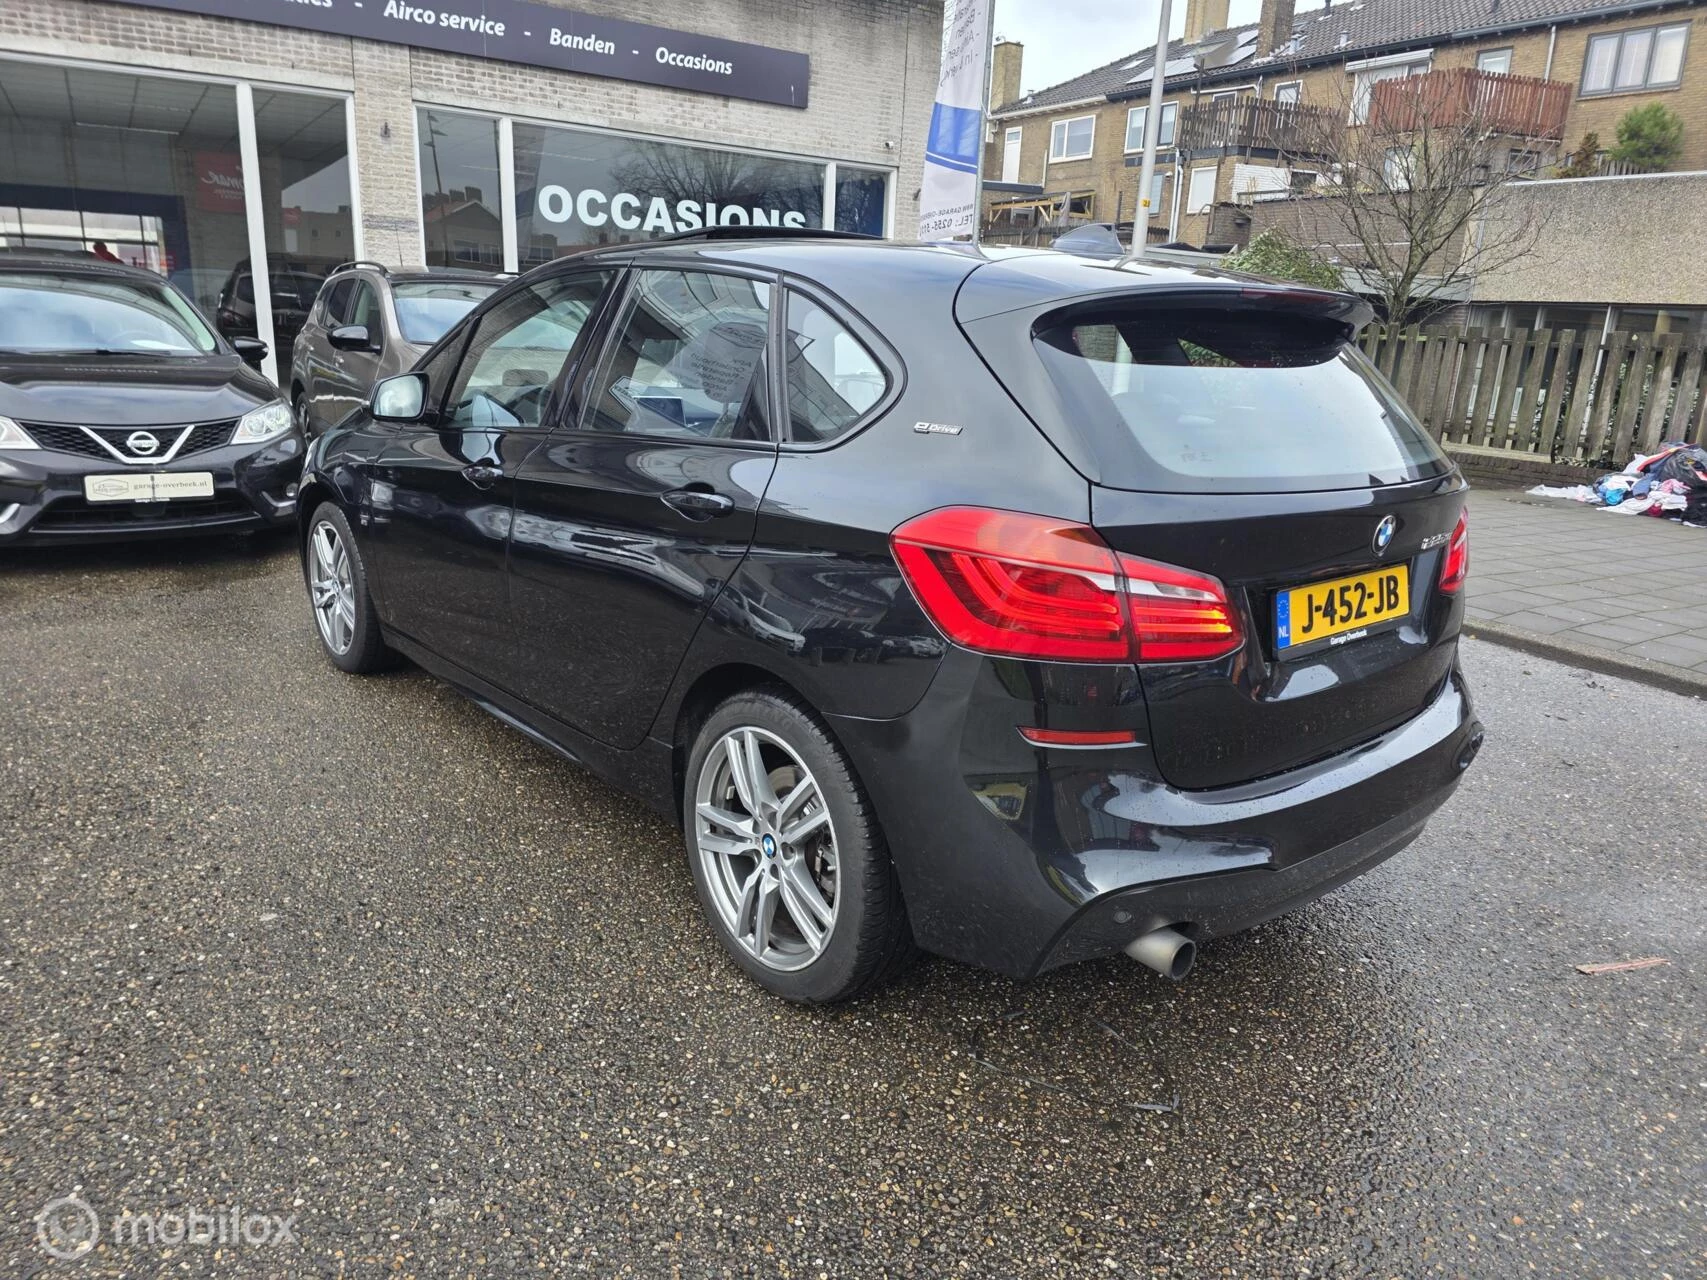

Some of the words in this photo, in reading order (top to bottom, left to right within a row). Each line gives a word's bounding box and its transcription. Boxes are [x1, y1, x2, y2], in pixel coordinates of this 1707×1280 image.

[383, 0, 436, 25] Airco
[439, 13, 506, 36] service
[550, 28, 616, 55] Banden
[655, 47, 734, 75] Occasions
[538, 184, 806, 234] OCCASIONS
[1301, 575, 1400, 634] J-452-JB
[1278, 626, 1289, 639] NL
